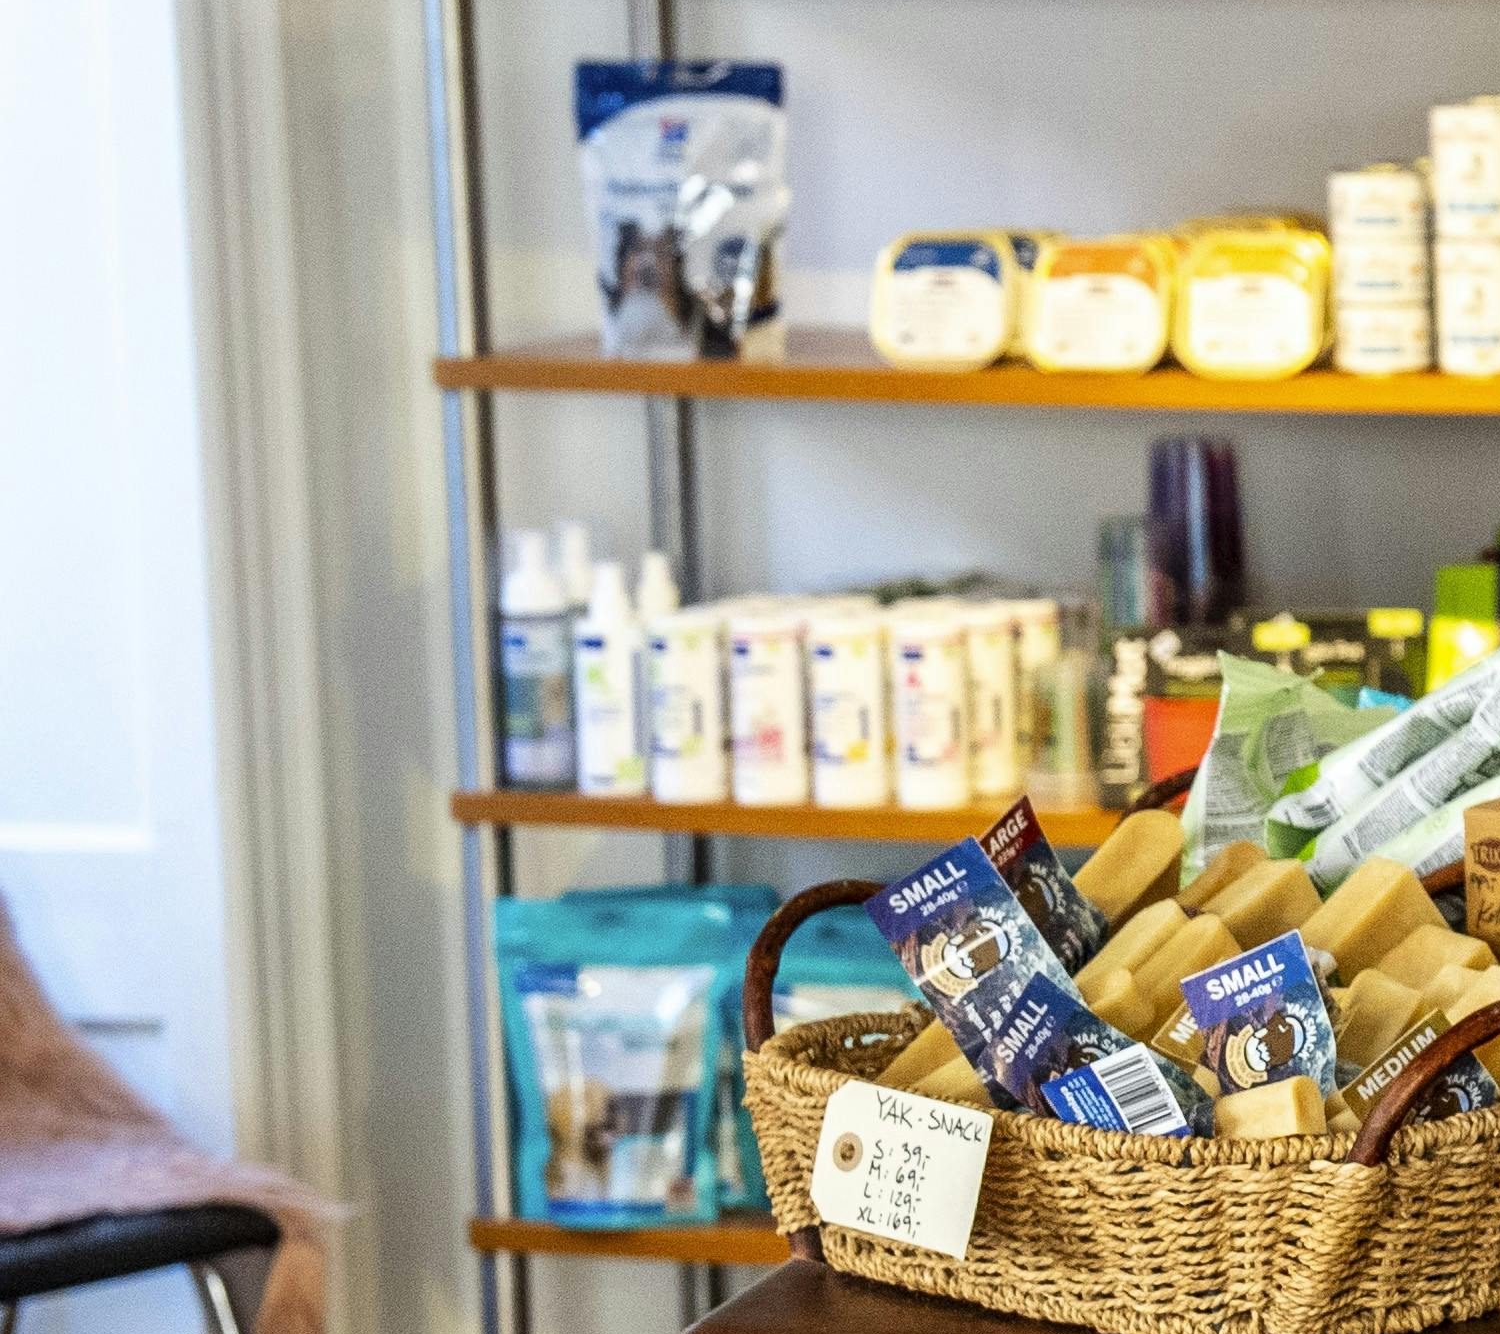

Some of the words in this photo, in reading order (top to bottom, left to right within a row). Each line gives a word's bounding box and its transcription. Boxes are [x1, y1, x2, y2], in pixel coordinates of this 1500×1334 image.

[990, 809, 1028, 857] ARGE
[889, 861, 967, 914] SMALL
[979, 906, 1005, 924] YAK
[1206, 954, 1285, 1001] SMALL
[996, 999, 1049, 1064] SMALL
[1073, 1033, 1100, 1046] YAK
[1286, 1003, 1309, 1018] YAK
[1298, 1017, 1317, 1061] SNACK
